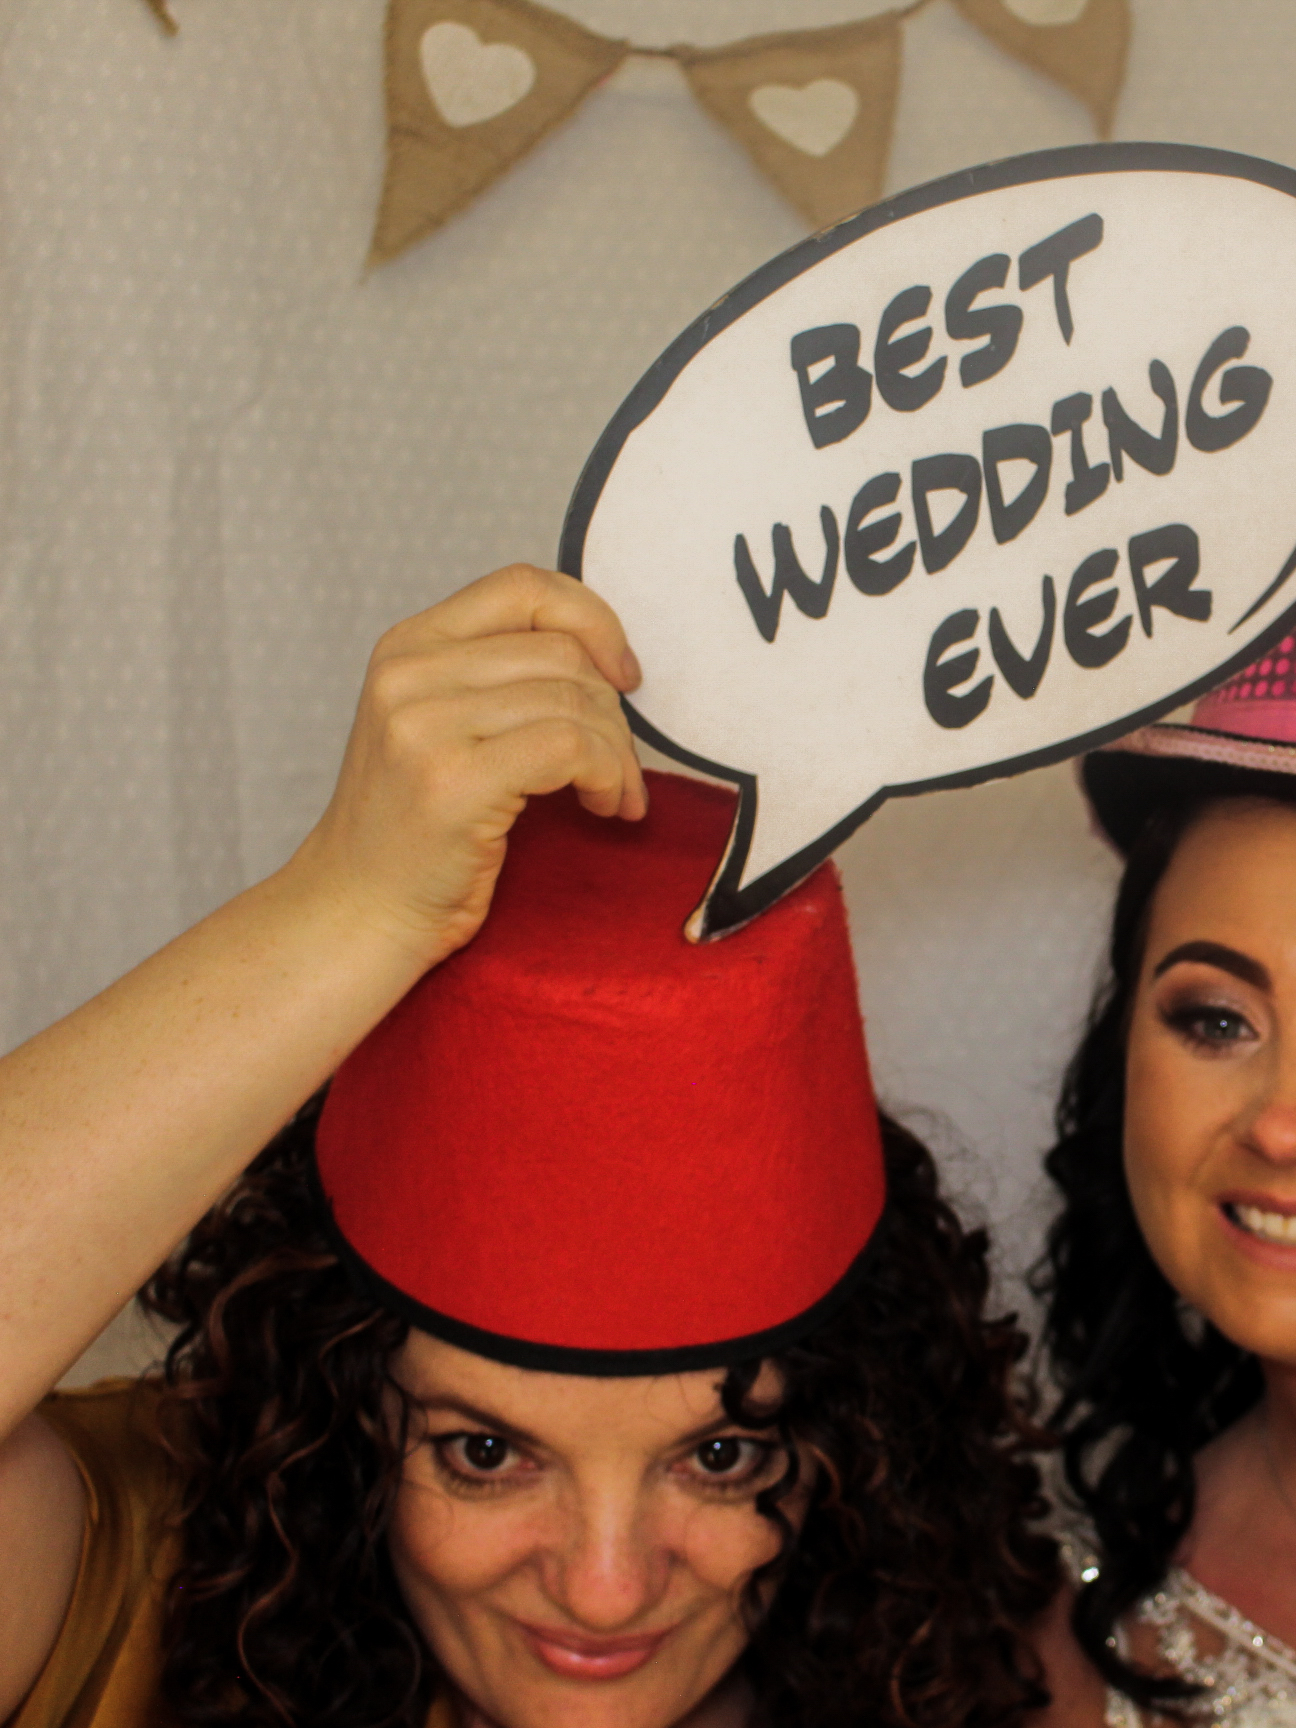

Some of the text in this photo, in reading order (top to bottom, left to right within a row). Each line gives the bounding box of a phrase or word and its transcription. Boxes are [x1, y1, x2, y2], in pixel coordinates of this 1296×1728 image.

[790, 213, 1104, 450] BEST
[733, 326, 1273, 644] WEDDING
[922, 523, 1213, 730] EVER
